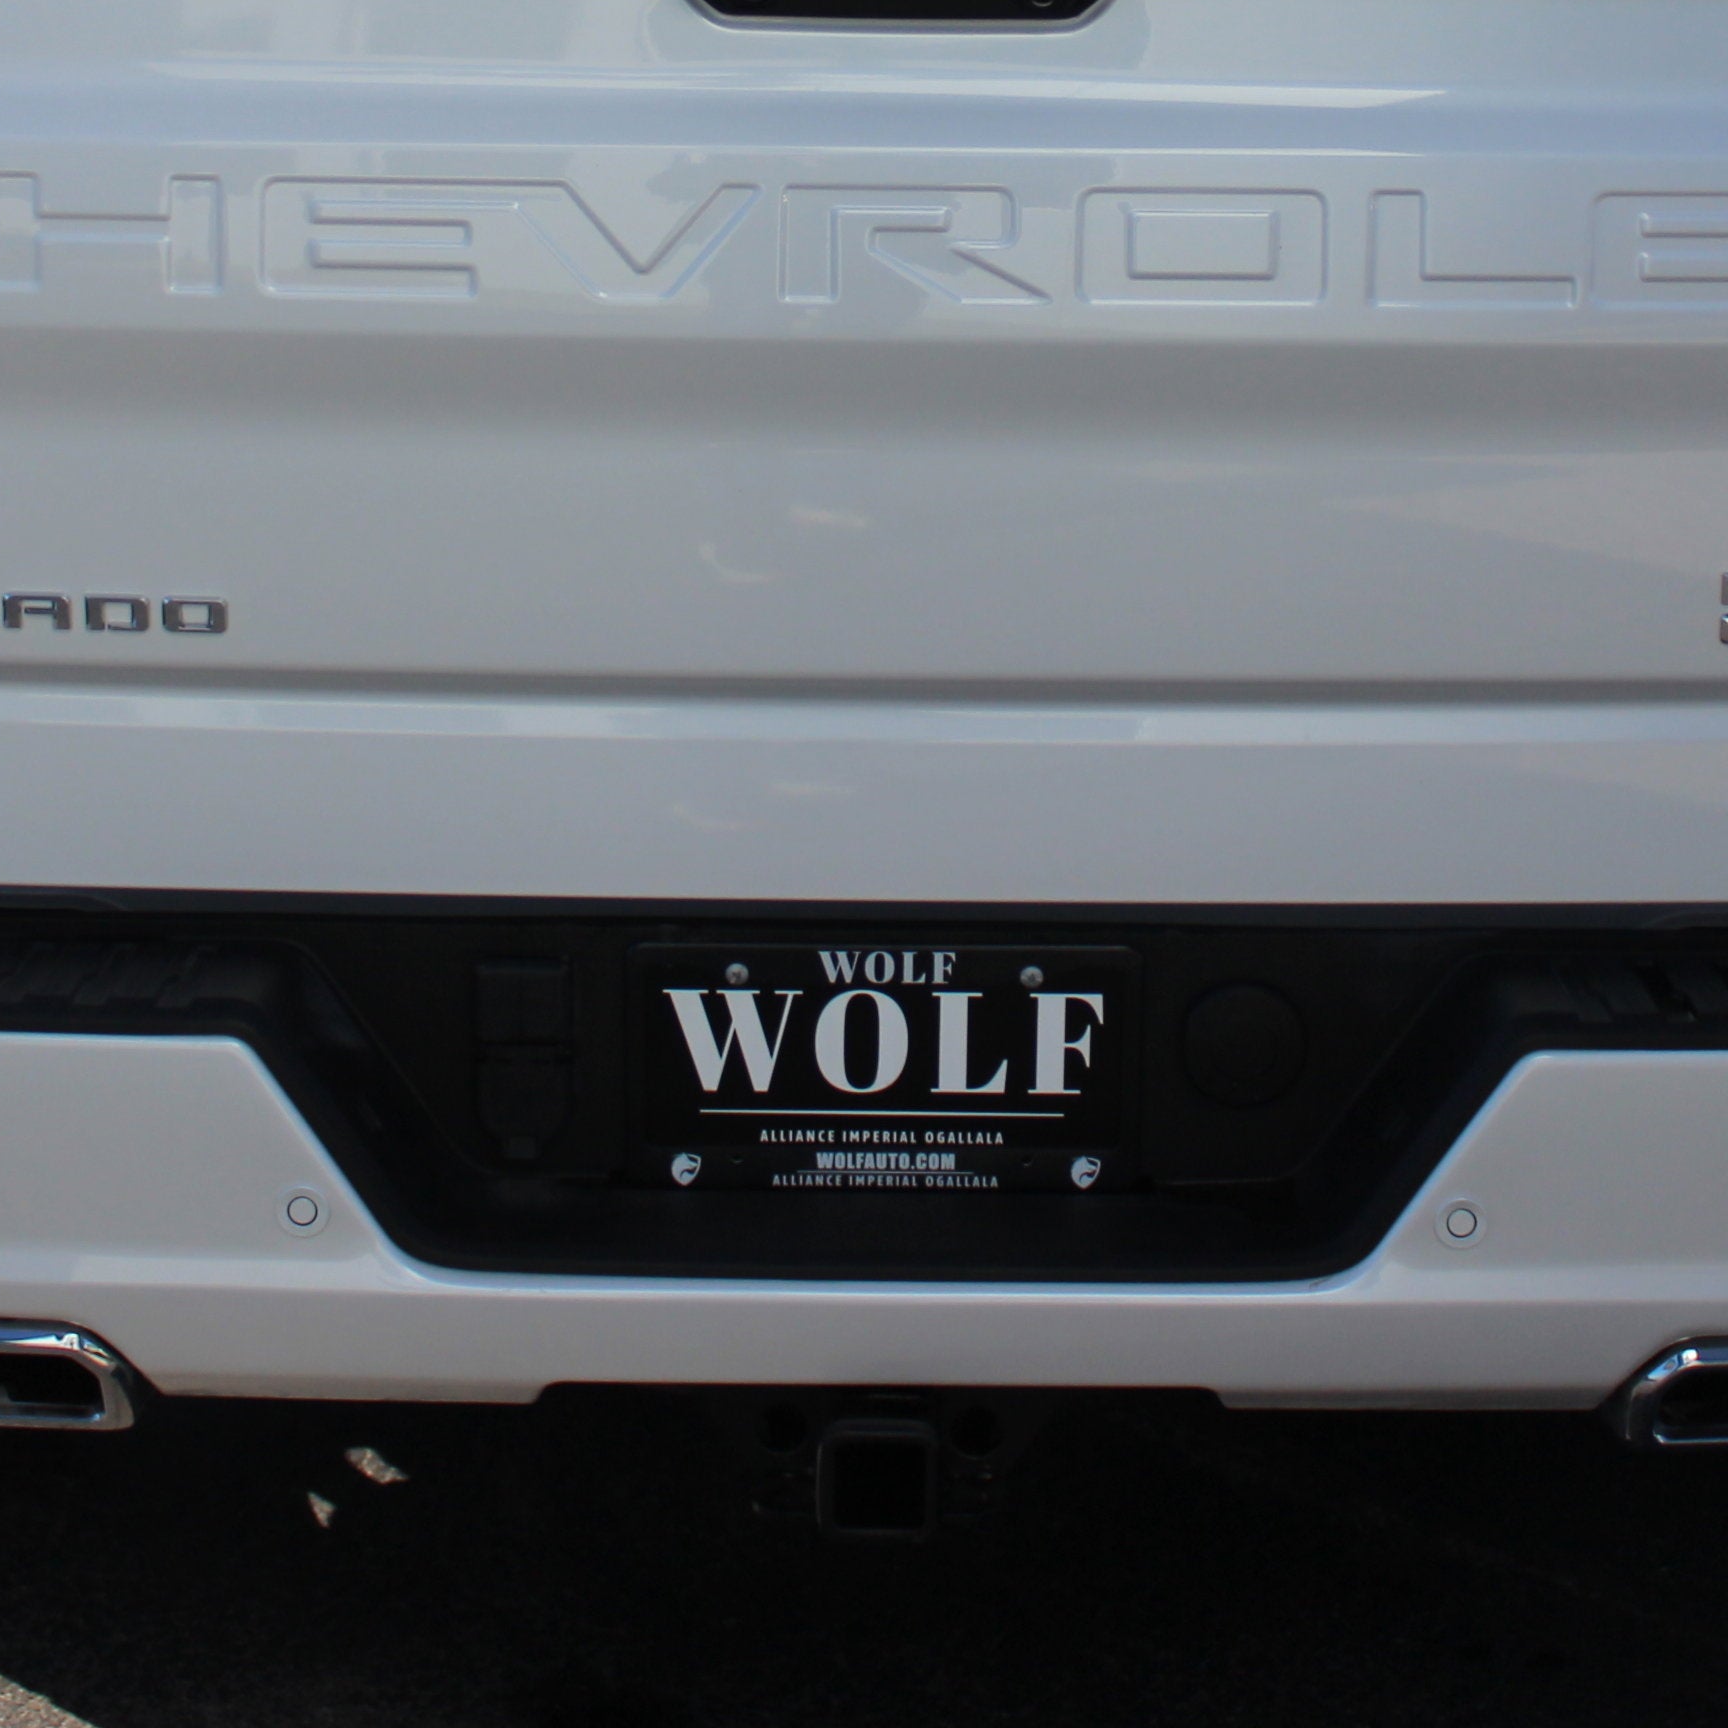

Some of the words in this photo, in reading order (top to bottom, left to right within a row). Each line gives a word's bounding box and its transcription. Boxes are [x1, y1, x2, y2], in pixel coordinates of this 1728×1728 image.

[818, 950, 957, 985] WOLF
[662, 988, 1104, 1095] WOLF
[760, 1129, 836, 1144] ALLIANCE
[842, 1130, 918, 1145] IMPERIAL
[924, 1131, 1005, 1146] OGALLALA
[816, 1152, 956, 1171] WOLFAUTO.COM
[772, 1174, 843, 1187] ALLIANCE
[849, 1175, 919, 1188] IMPERIAL
[925, 1175, 999, 1189] OGALLALA
